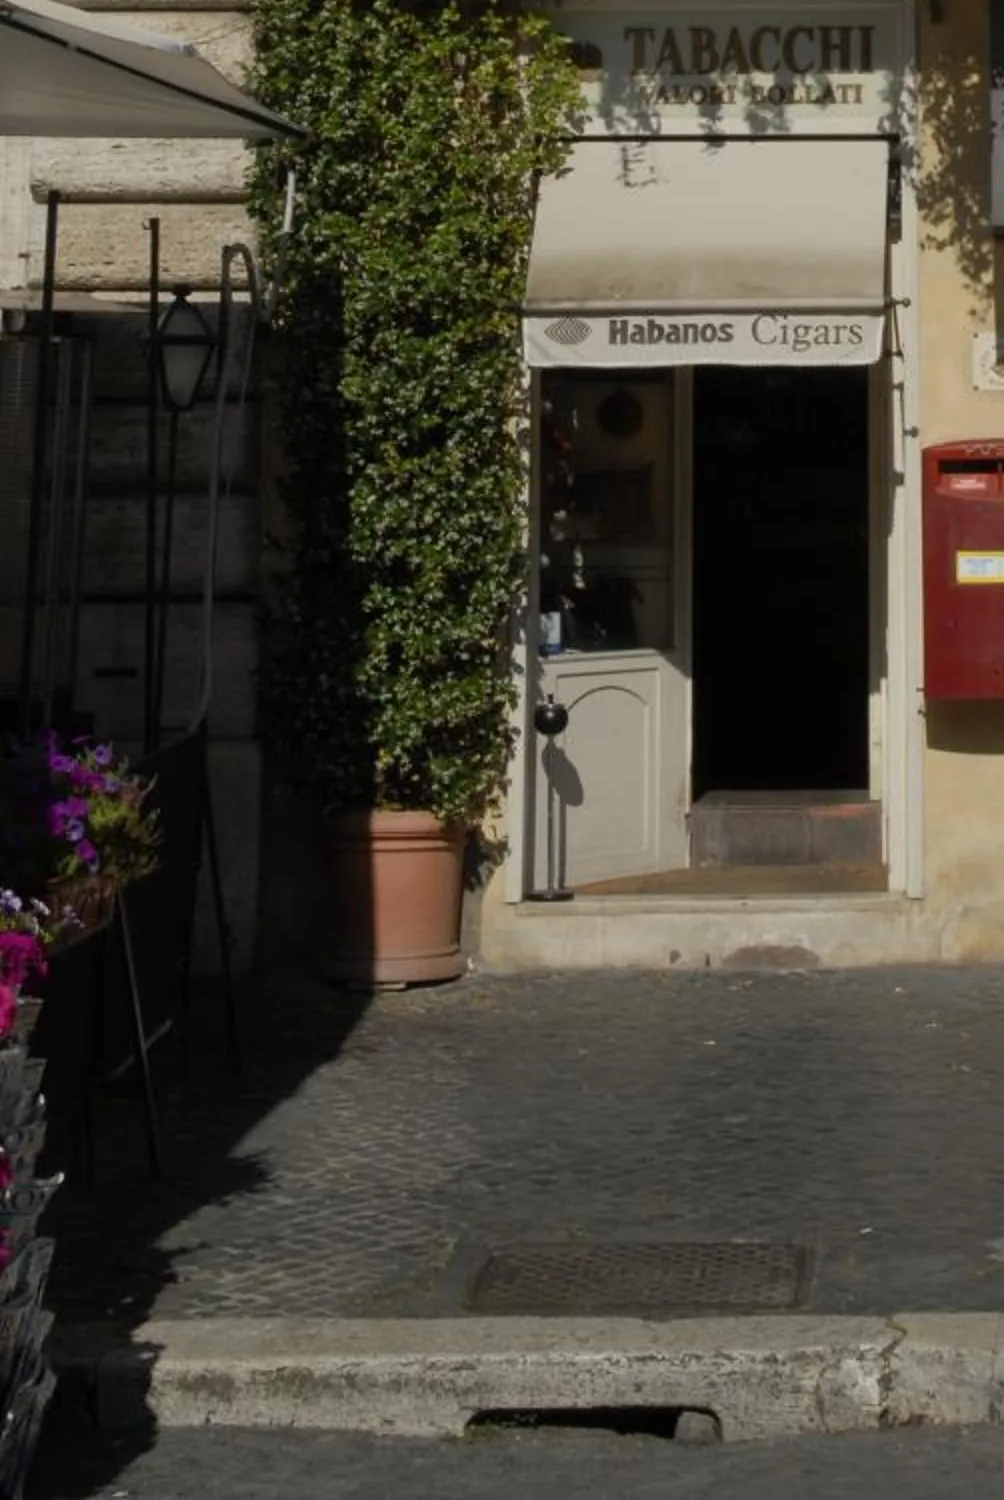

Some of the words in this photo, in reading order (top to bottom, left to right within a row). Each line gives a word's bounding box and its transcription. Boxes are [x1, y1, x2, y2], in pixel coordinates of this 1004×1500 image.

[623, 25, 876, 76] TABACCHI
[641, 83, 737, 105] VALORI
[750, 82, 864, 105] BOLLATI
[608, 319, 734, 345] Habanos
[751, 313, 864, 352] Cigars
